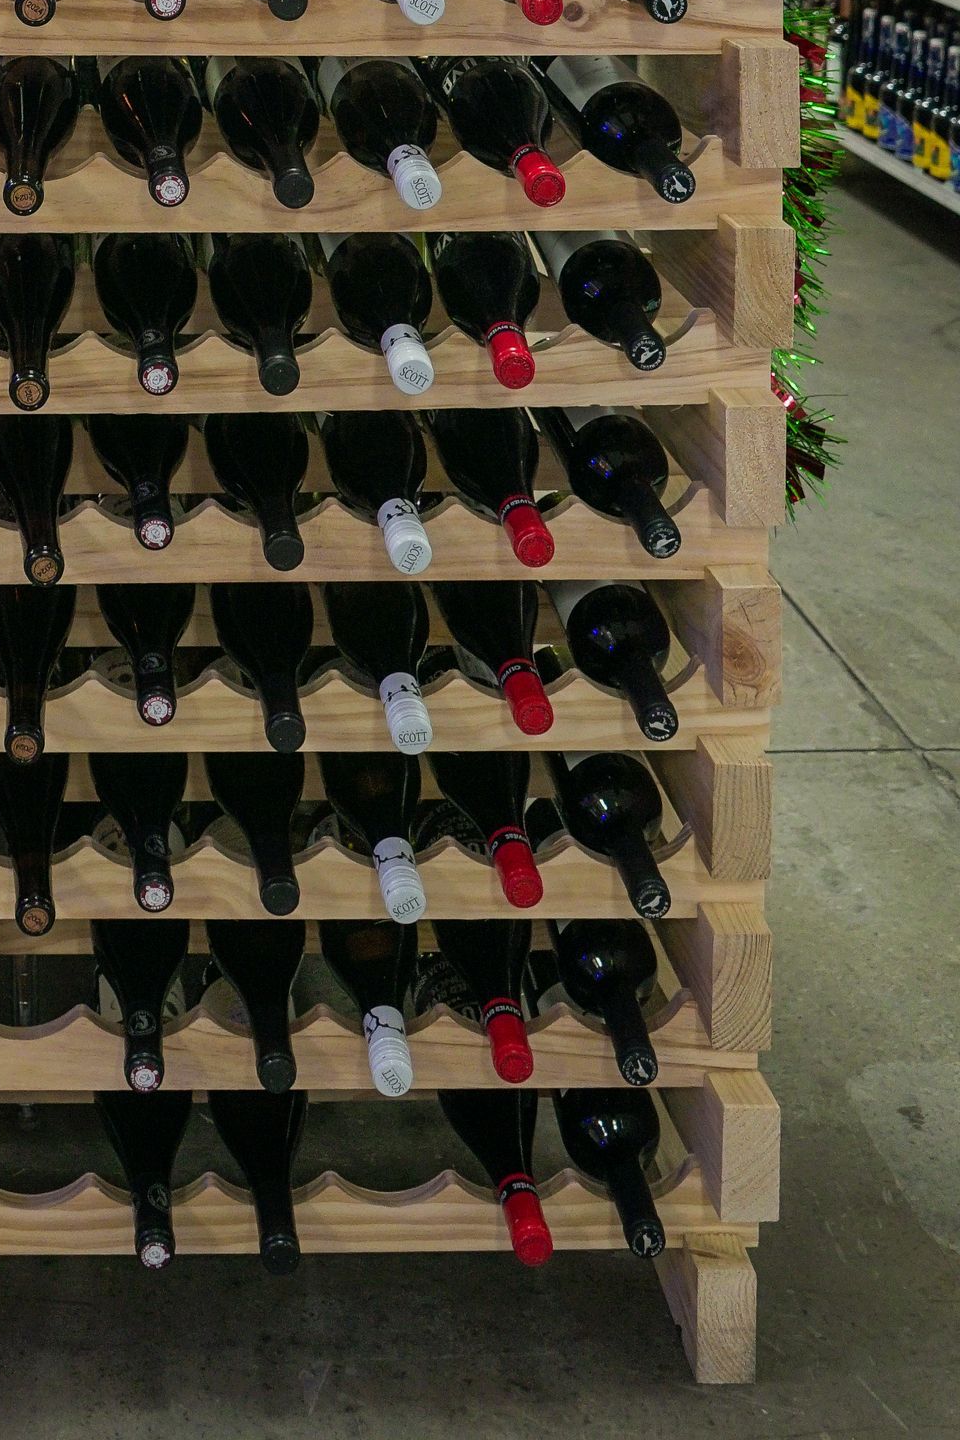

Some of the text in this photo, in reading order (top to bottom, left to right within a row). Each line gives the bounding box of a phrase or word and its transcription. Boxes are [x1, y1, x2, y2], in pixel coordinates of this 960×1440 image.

[412, 177, 432, 206] SCOTT
[399, 366, 430, 388] SCOTT
[402, 543, 423, 572] SCOTT
[398, 731, 428, 744] SCOTT
[392, 896, 420, 916] SCOTT
[382, 1069, 404, 1094] SCOTT
